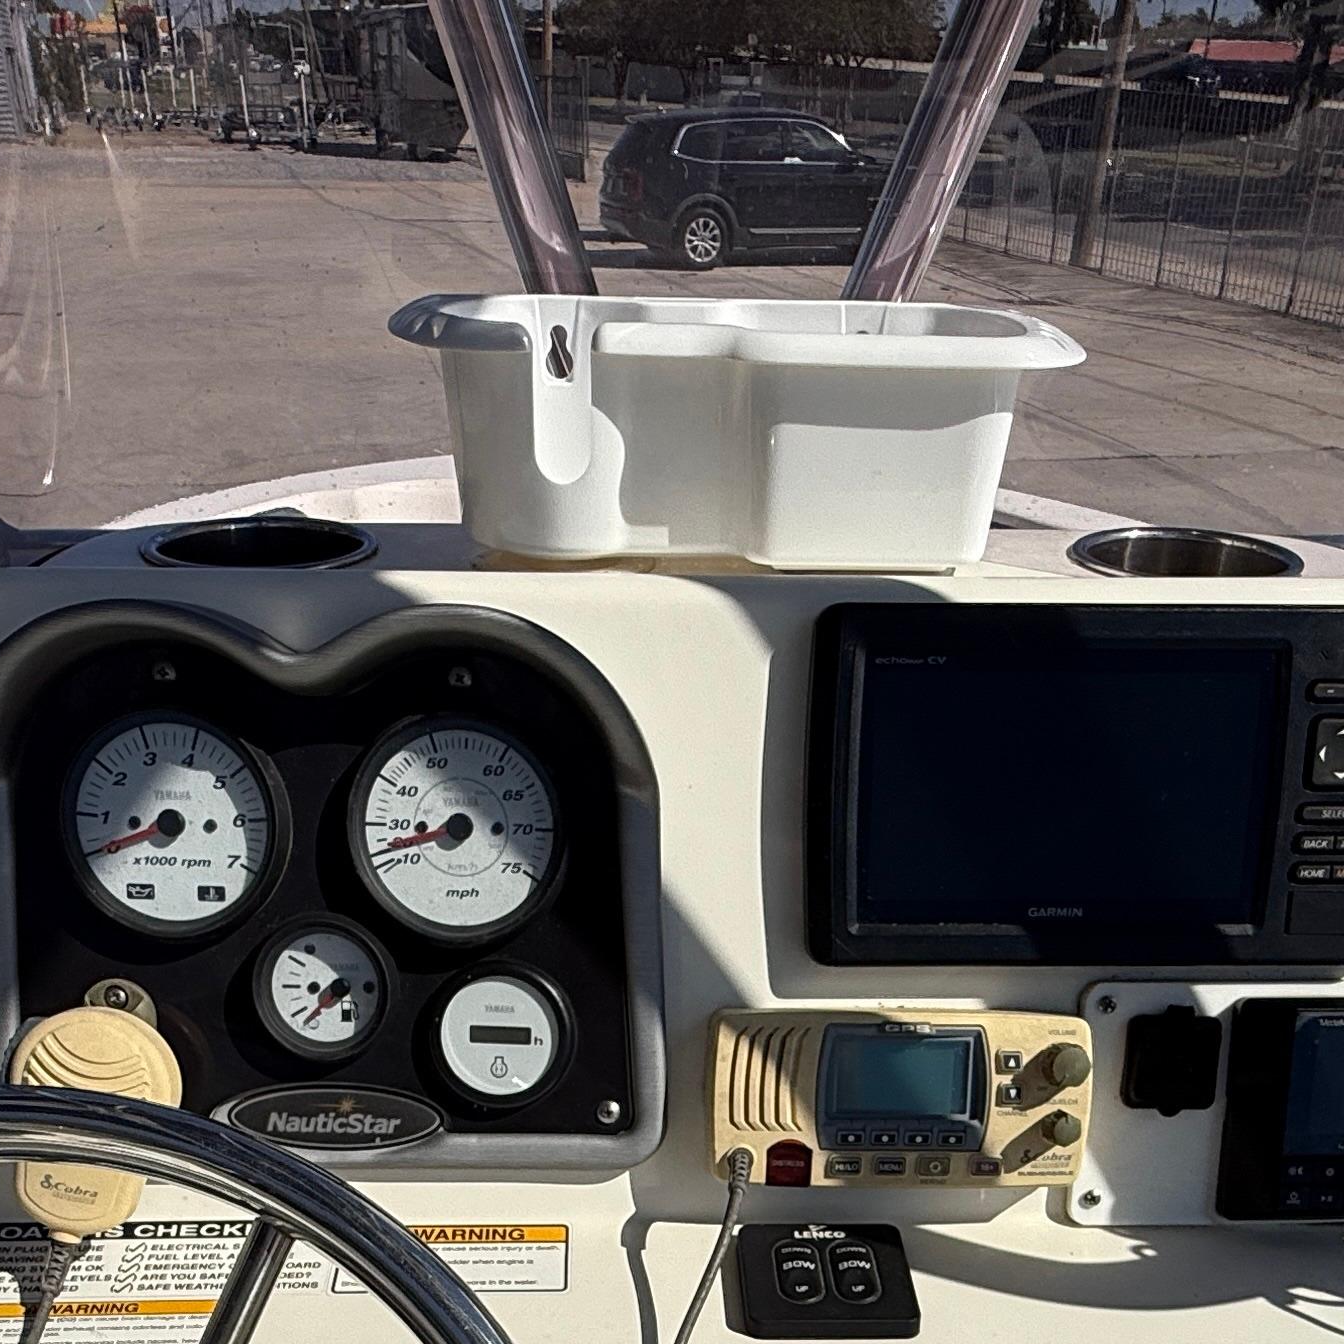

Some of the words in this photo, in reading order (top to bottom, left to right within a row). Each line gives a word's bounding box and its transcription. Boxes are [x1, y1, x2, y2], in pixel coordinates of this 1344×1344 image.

[143, 752, 157, 767] 3
[181, 753, 194, 768] 4
[426, 757, 448, 770] 50
[482, 764, 505, 777] 60
[112, 771, 128, 786] 2
[213, 775, 228, 790] 5
[154, 790, 192, 801] YAMAHA
[396, 785, 419, 798] 40
[502, 789, 524, 801] 65
[98, 811, 110, 824] 1
[233, 813, 246, 828] 6
[388, 818, 411, 831] 30
[512, 823, 533, 836] 70
[1303, 839, 1329, 849] BACK
[132, 856, 177, 867] x1000
[181, 857, 212, 869] rpm
[226, 855, 242, 869] 7
[402, 853, 421, 865] 10
[500, 861, 522, 875] 75
[1299, 868, 1326, 878] HOME
[446, 888, 480, 900] mph
[1028, 907, 1083, 917] GARMIN
[885, 1023, 932, 1034] GPS
[532, 1035, 544, 1047] h
[266, 1111, 401, 1137] NauticStar
[878, 1162, 903, 1171] MENU
[54, 1181, 98, 1198] Cobra
[414, 1228, 525, 1241] WARNING
[794, 1229, 846, 1240] LENCO
[151, 1243, 229, 1251] ELECTRICAL
[147, 1253, 181, 1261] FUEL
[85, 1264, 104, 1272] OK
[782, 1259, 816, 1271] BOW
[838, 1259, 871, 1271] BOW
[140, 1273, 168, 1281] ARE
[170, 1273, 196, 1281] YOU
[137, 1283, 171, 1291] SAFE
[795, 1284, 809, 1293] UP
[851, 1284, 865, 1293] UP
